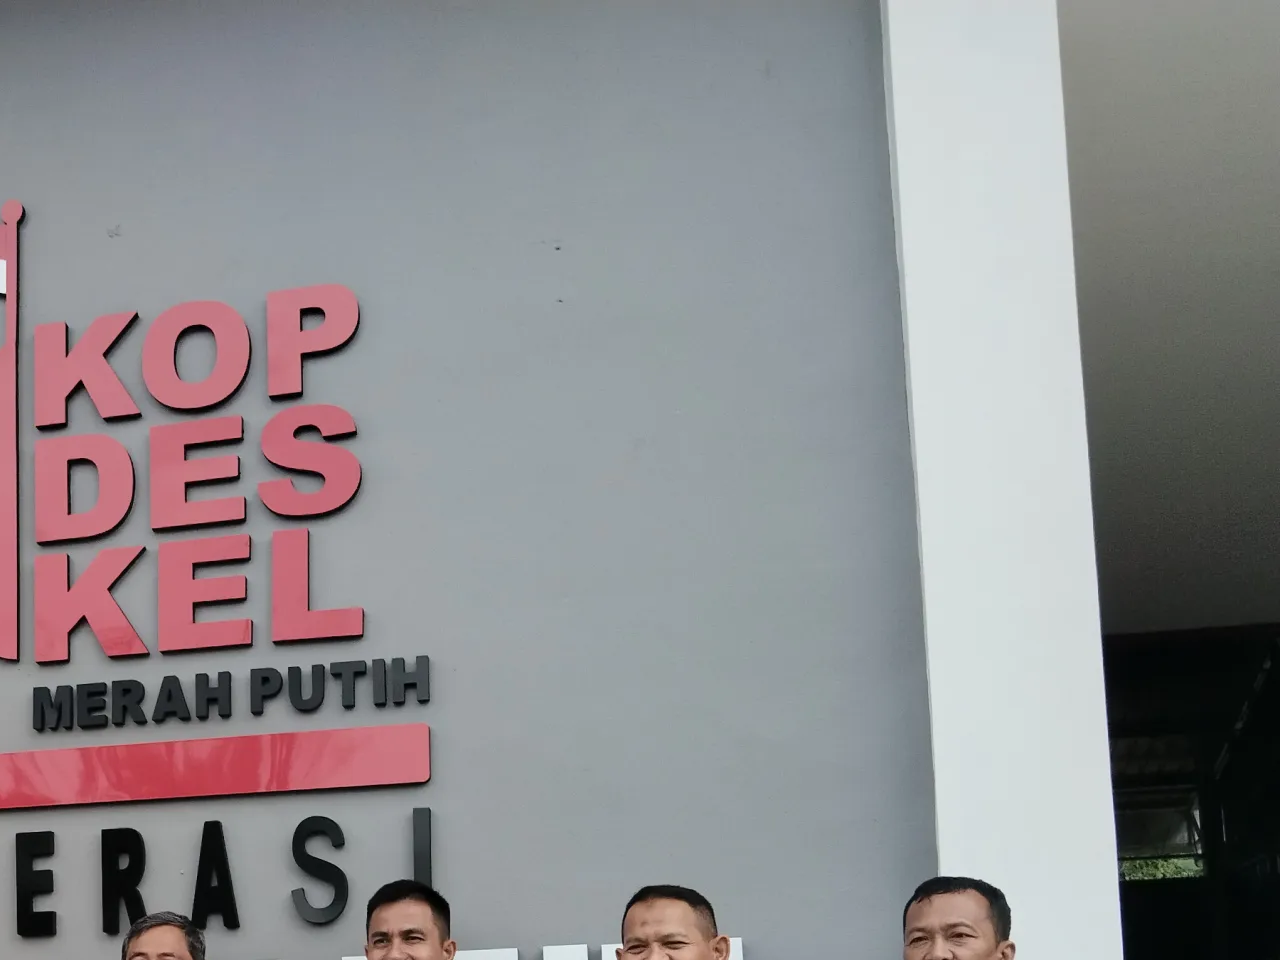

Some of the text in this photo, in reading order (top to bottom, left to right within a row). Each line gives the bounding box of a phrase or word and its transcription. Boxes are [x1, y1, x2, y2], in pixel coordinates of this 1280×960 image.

[34, 283, 361, 429] KOP
[34, 403, 363, 545] DES
[34, 527, 365, 665] KEL
[32, 655, 431, 732] MERAH PUTIH
